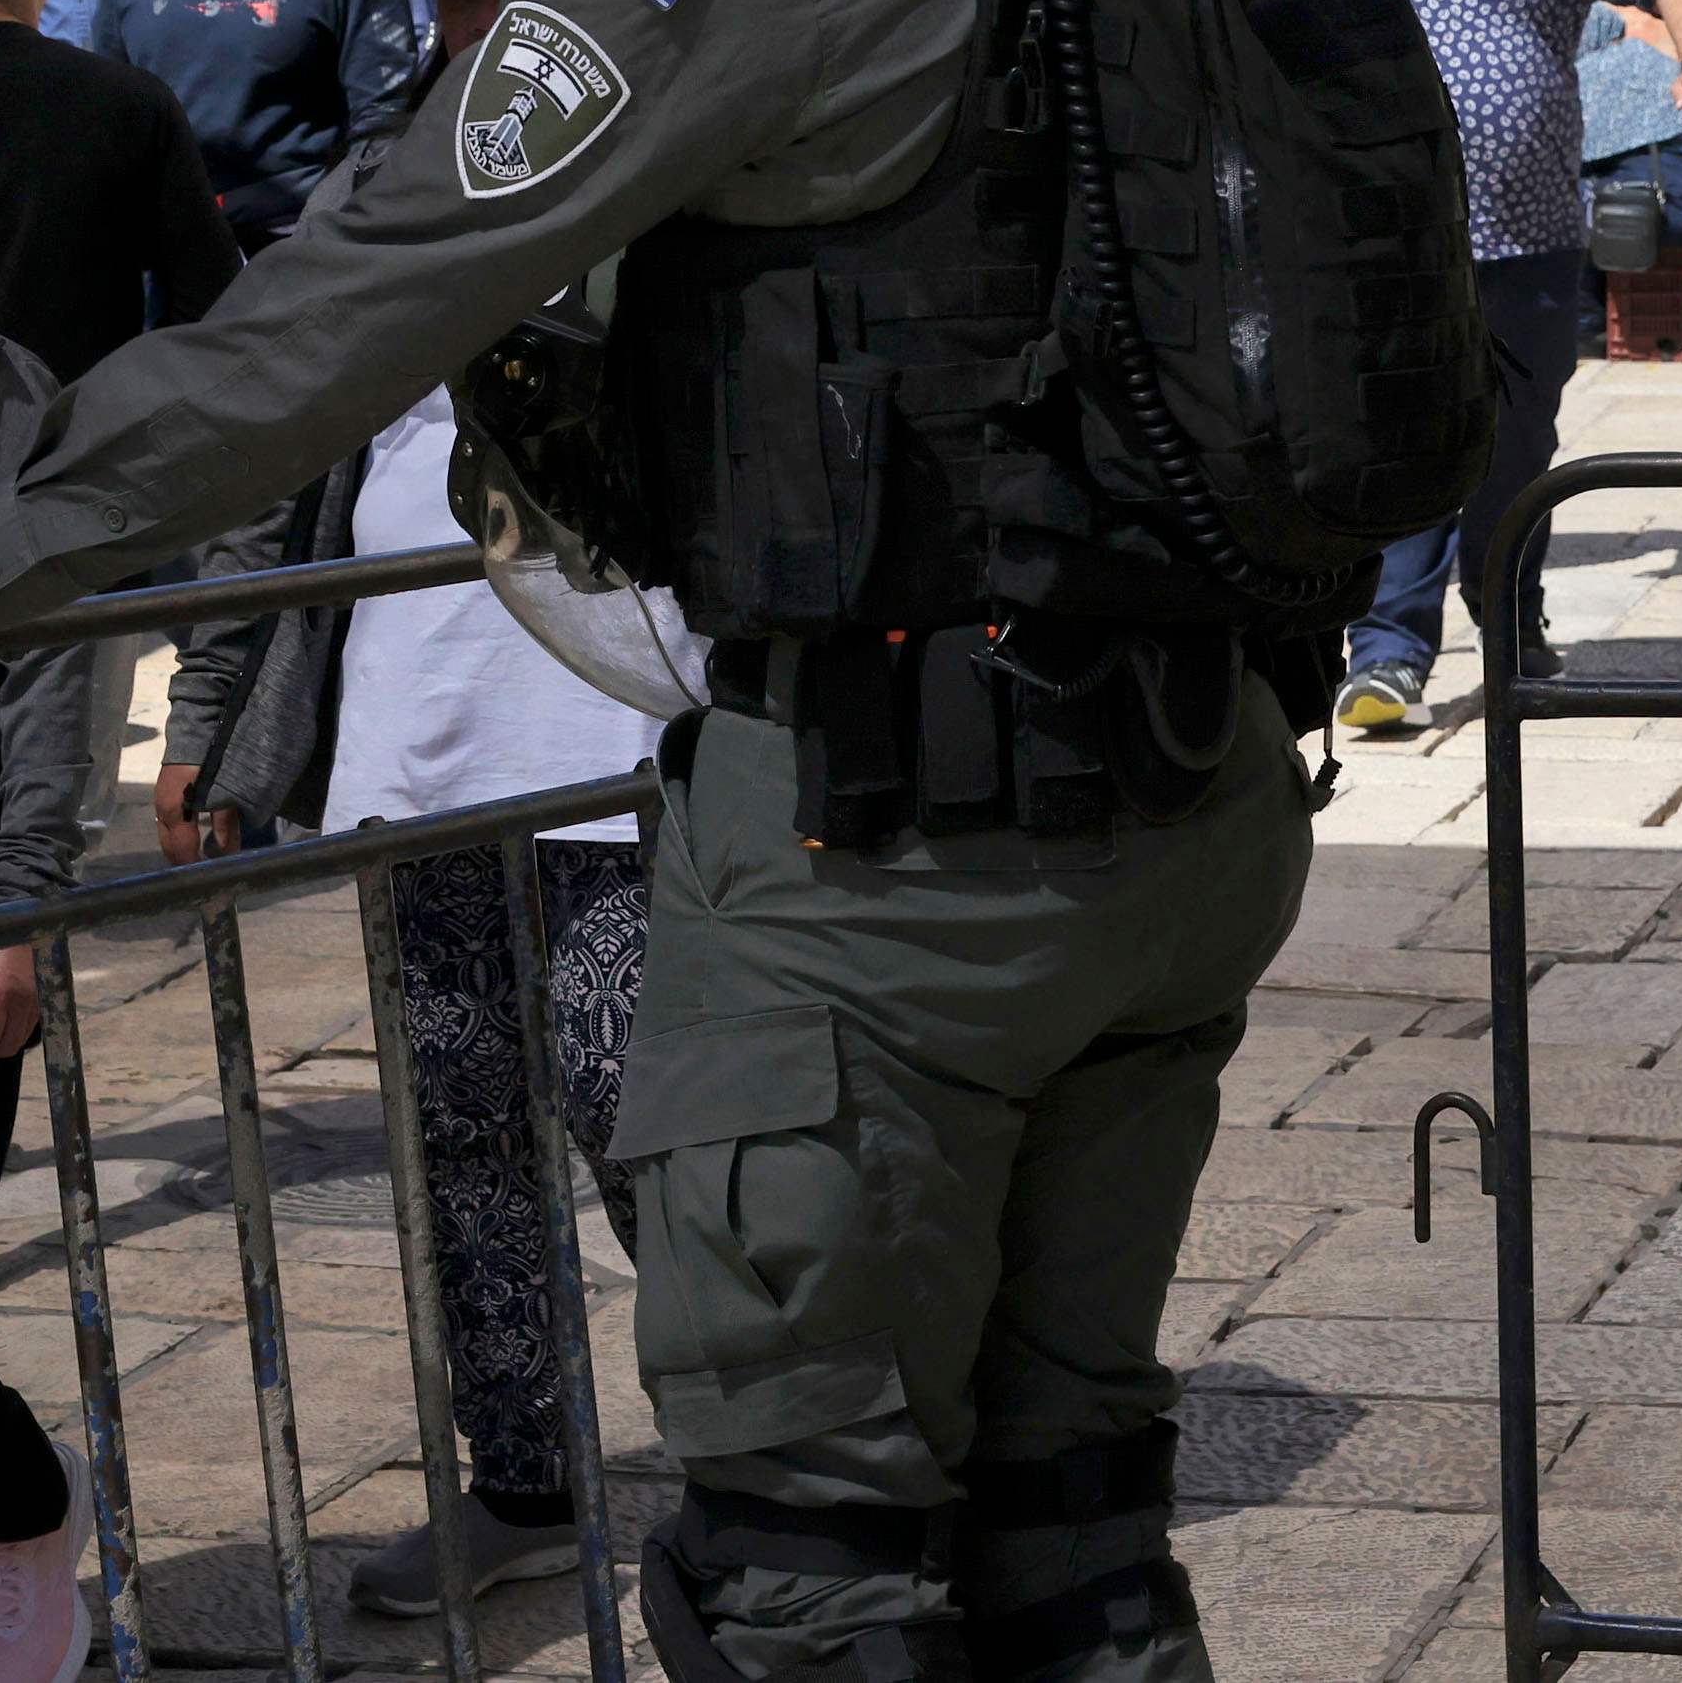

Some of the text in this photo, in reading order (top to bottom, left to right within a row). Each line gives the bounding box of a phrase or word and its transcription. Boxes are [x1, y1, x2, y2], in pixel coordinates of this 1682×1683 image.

[509, 12, 611, 98] משטרת ישראל
[467, 126, 528, 176] משמר הגבול
